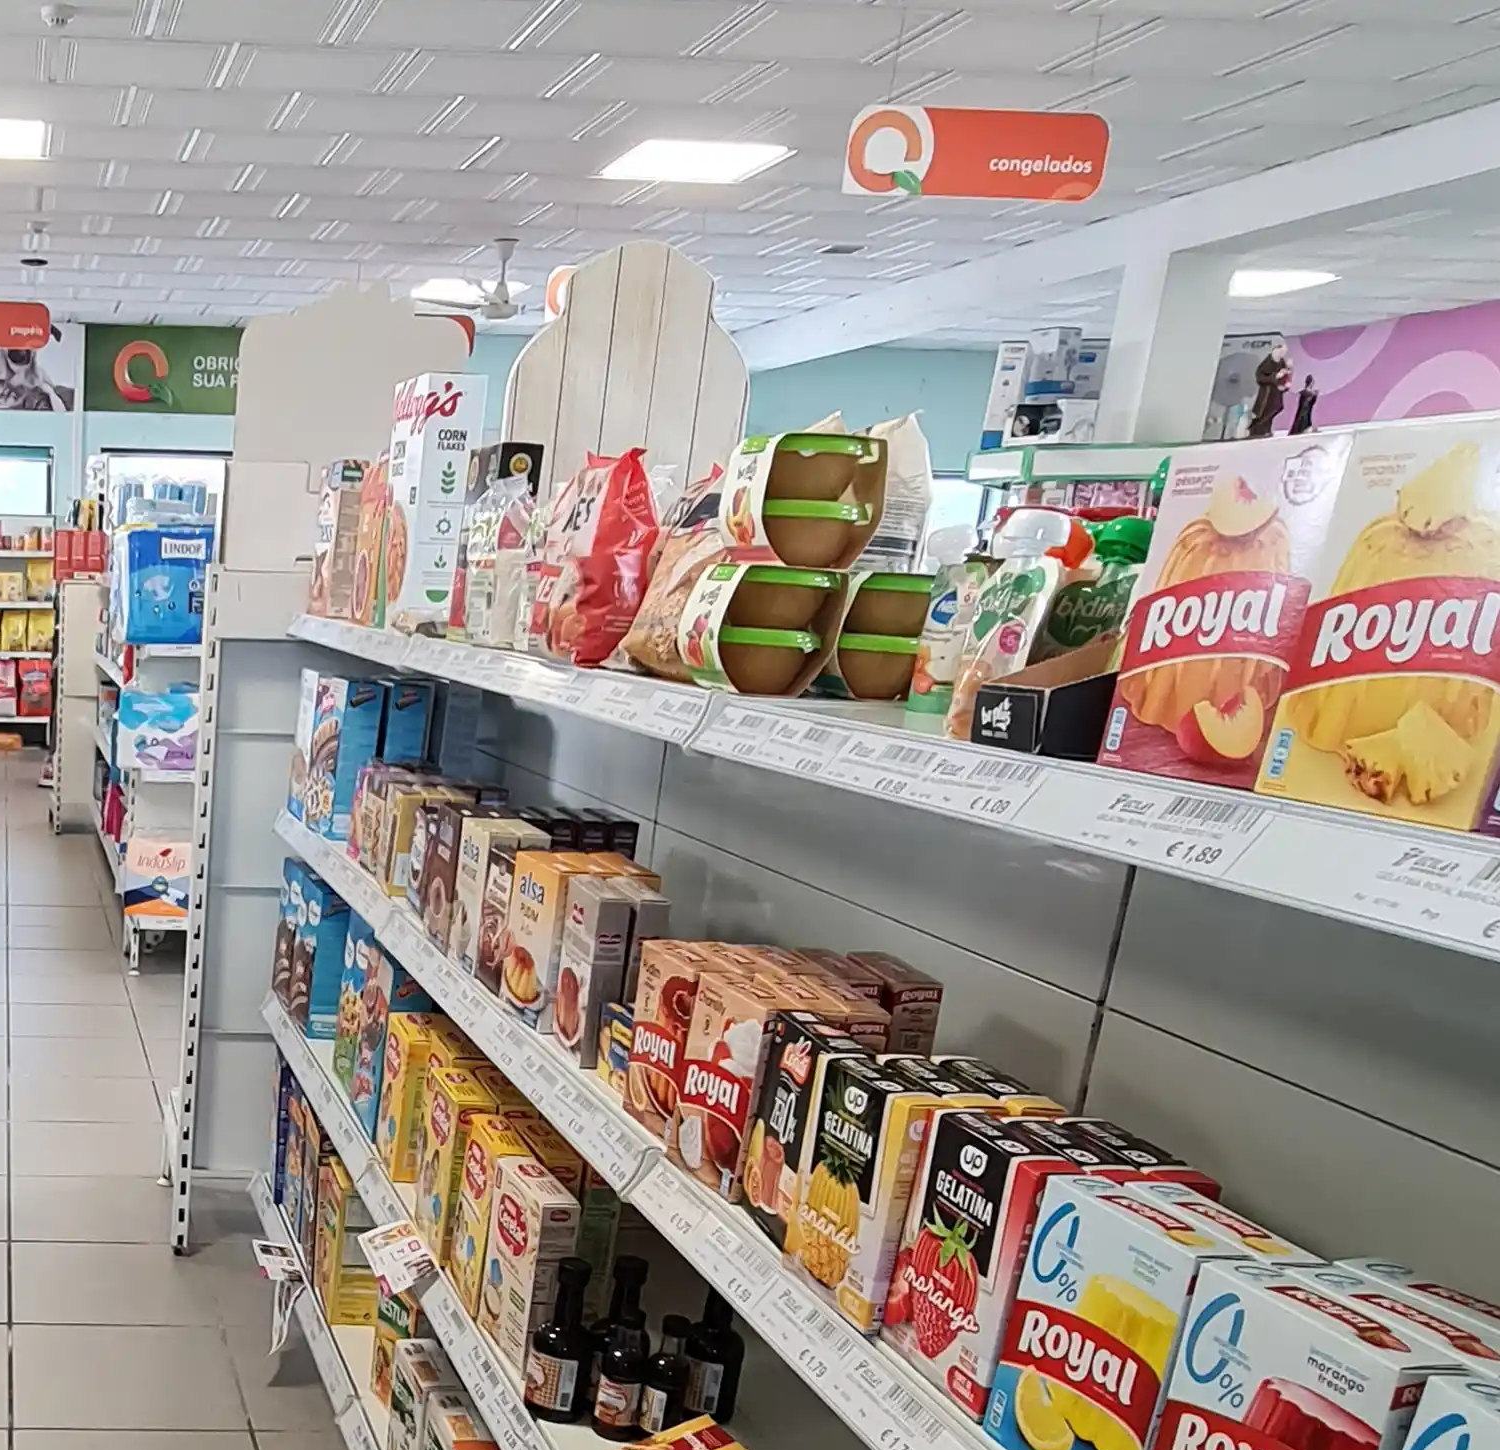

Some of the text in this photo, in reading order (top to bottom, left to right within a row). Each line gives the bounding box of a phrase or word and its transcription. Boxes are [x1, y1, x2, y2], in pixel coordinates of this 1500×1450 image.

[988, 153, 1093, 177] congelados
[192, 373, 225, 388] SUA
[437, 440, 466, 452] FLAKES
[438, 428, 468, 442] CORN
[1139, 582, 1287, 654] Royal
[1310, 590, 1500, 670] Royal
[1166, 840, 1223, 867] € 1,89
[519, 871, 545, 905] alsa
[633, 1025, 676, 1069] Royal
[684, 1064, 740, 1115] Royal
[823, 1111, 874, 1159] GELATINA
[935, 1169, 995, 1228] GELATINA
[901, 1264, 980, 1335] morango
[1016, 1309, 1140, 1407] Royal
[1307, 1355, 1366, 1395] morango
[1317, 1372, 1348, 1397] fresa
